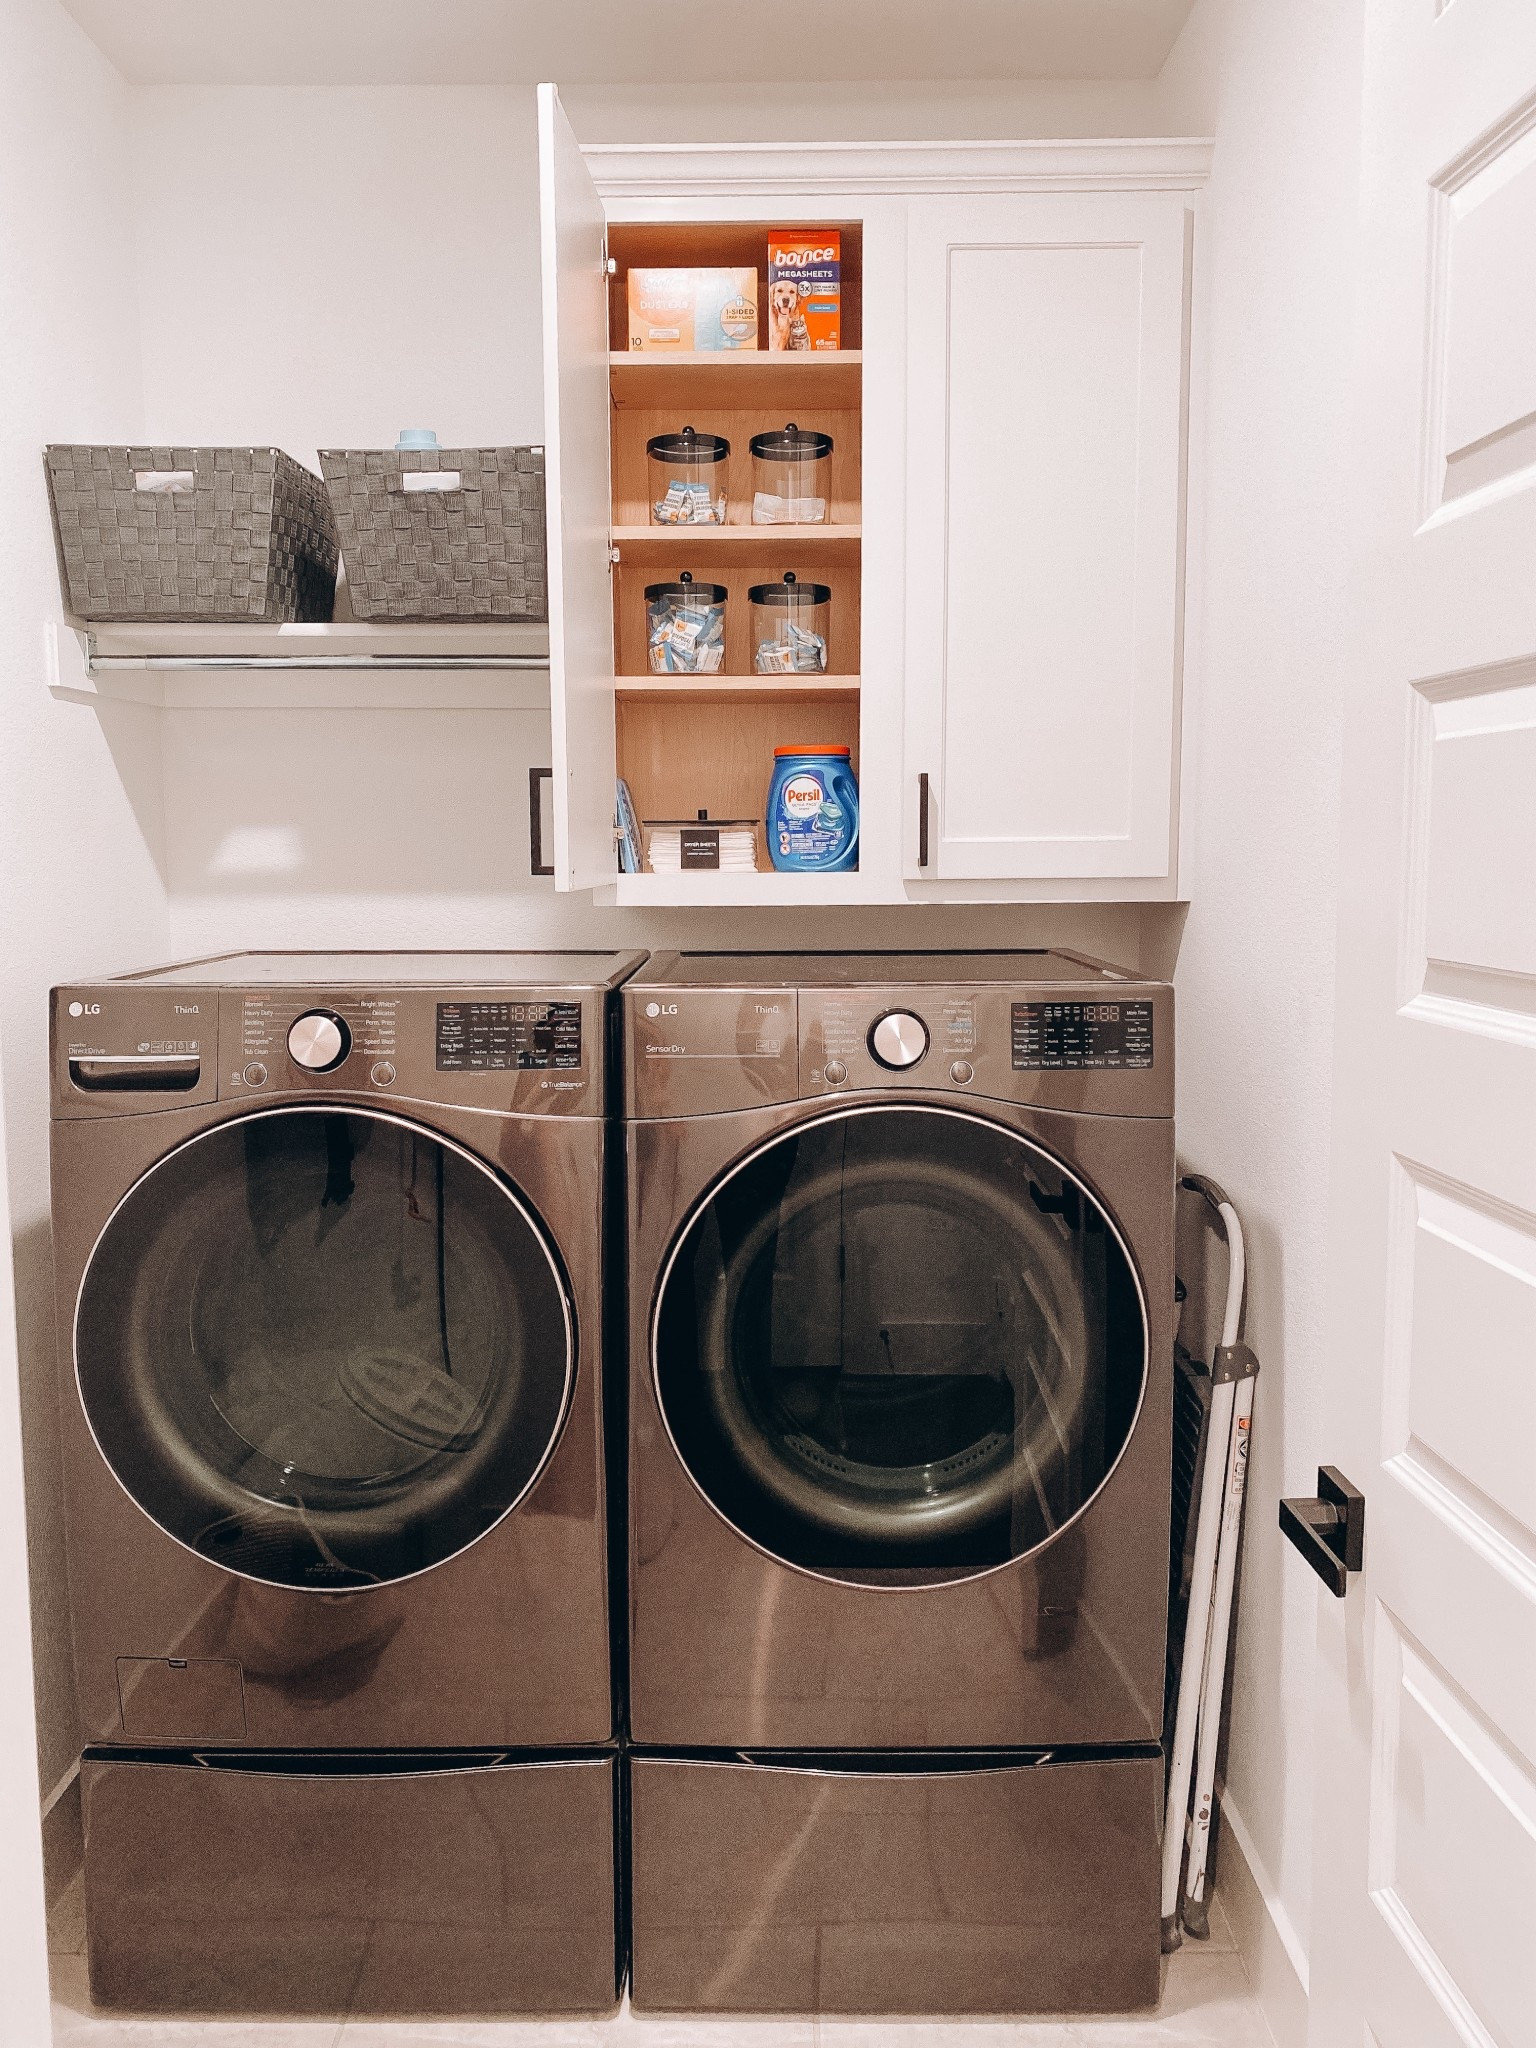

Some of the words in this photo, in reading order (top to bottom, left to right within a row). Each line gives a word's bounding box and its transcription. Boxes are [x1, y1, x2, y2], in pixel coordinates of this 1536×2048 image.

[775, 247, 834, 268] bounce
[778, 270, 833, 278] MEGASHEETS
[631, 337, 642, 346] 10
[788, 789, 820, 803] Persil
[84, 1004, 100, 1015] LG
[174, 1005, 199, 1014] ThinQ
[661, 1004, 678, 1015] LG
[754, 1005, 779, 1014] ThinQ
